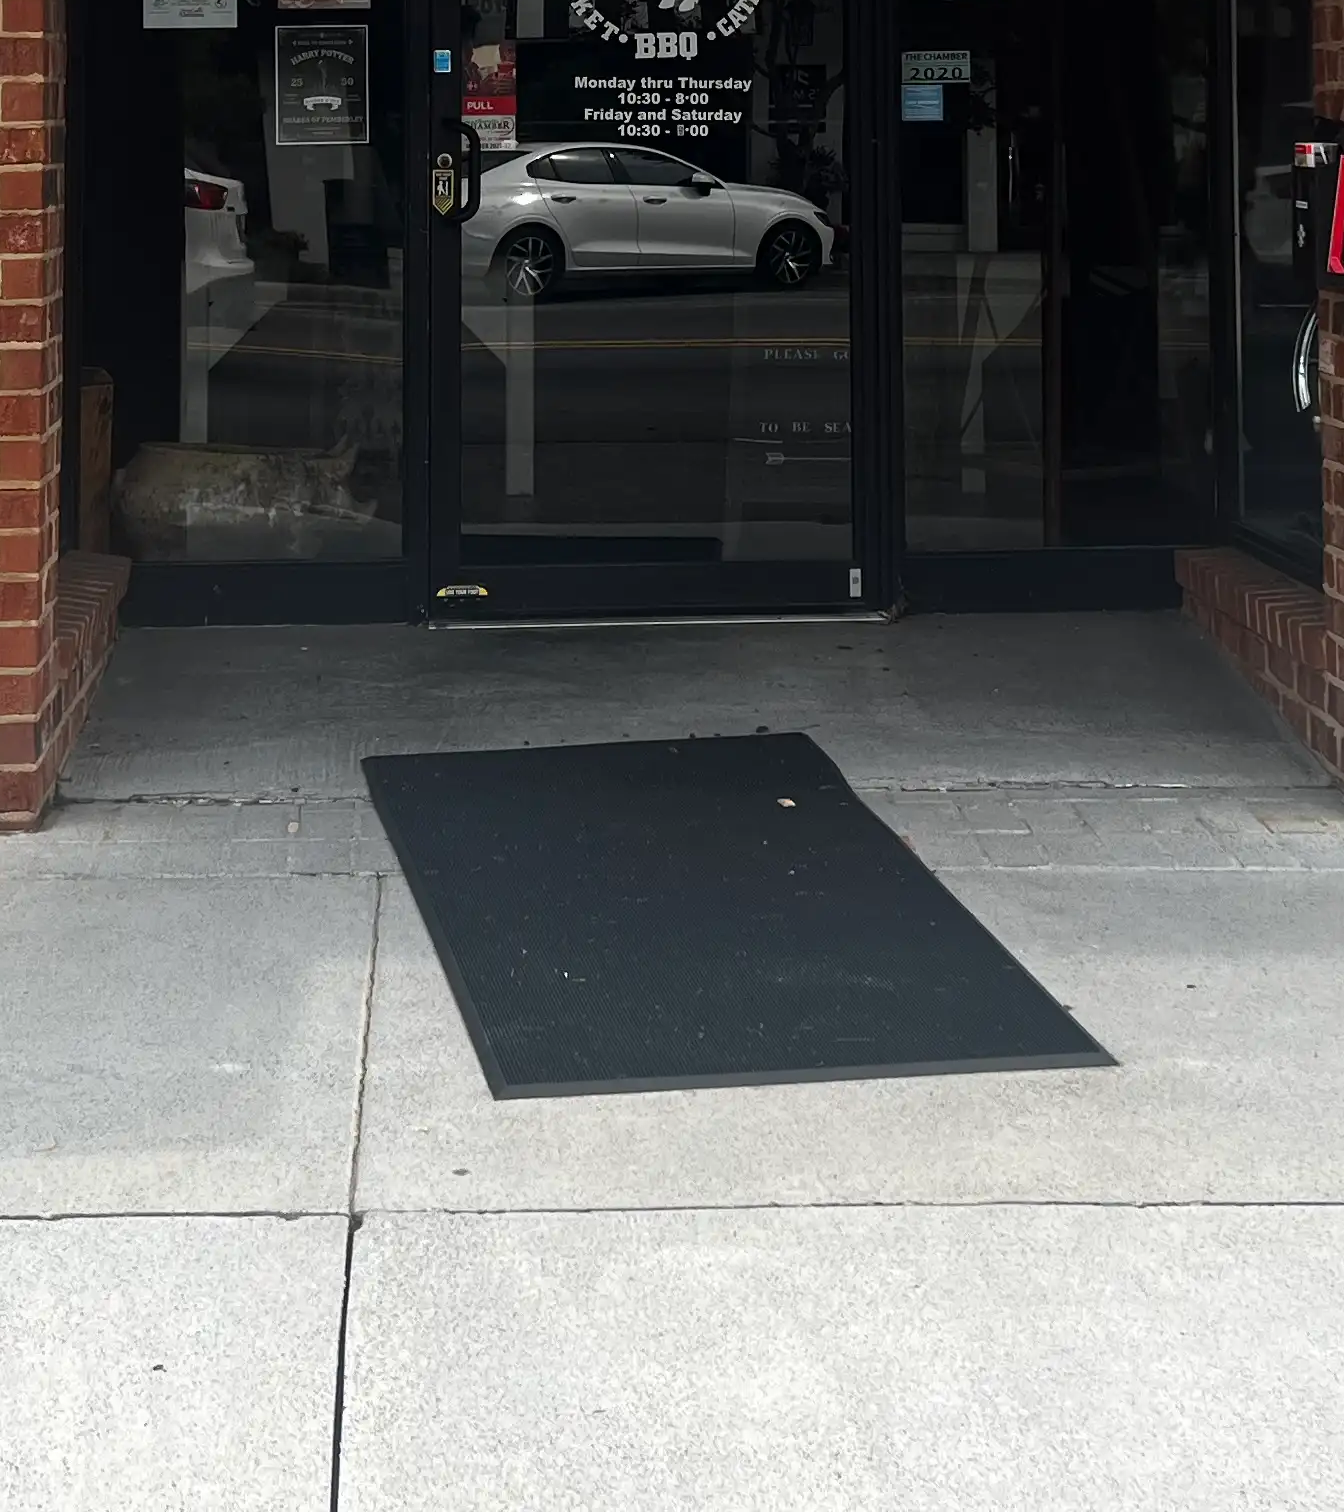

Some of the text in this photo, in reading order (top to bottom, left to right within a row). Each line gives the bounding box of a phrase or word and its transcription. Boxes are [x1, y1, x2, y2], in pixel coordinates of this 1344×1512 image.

[634, 31, 698, 61] BBQ
[290, 49, 355, 66] HARRY POTTER
[904, 52, 968, 61] THE CHAMBER
[910, 67, 963, 81] 2020
[574, 76, 752, 92] Monday thru Thursday
[467, 101, 494, 110] PULL
[617, 93, 661, 105] 10:30
[584, 108, 743, 124] Friday and Saturday
[617, 124, 661, 137] 10:30
[763, 348, 821, 360] PLEASE
[759, 421, 780, 433] TO
[791, 421, 812, 433] BE
